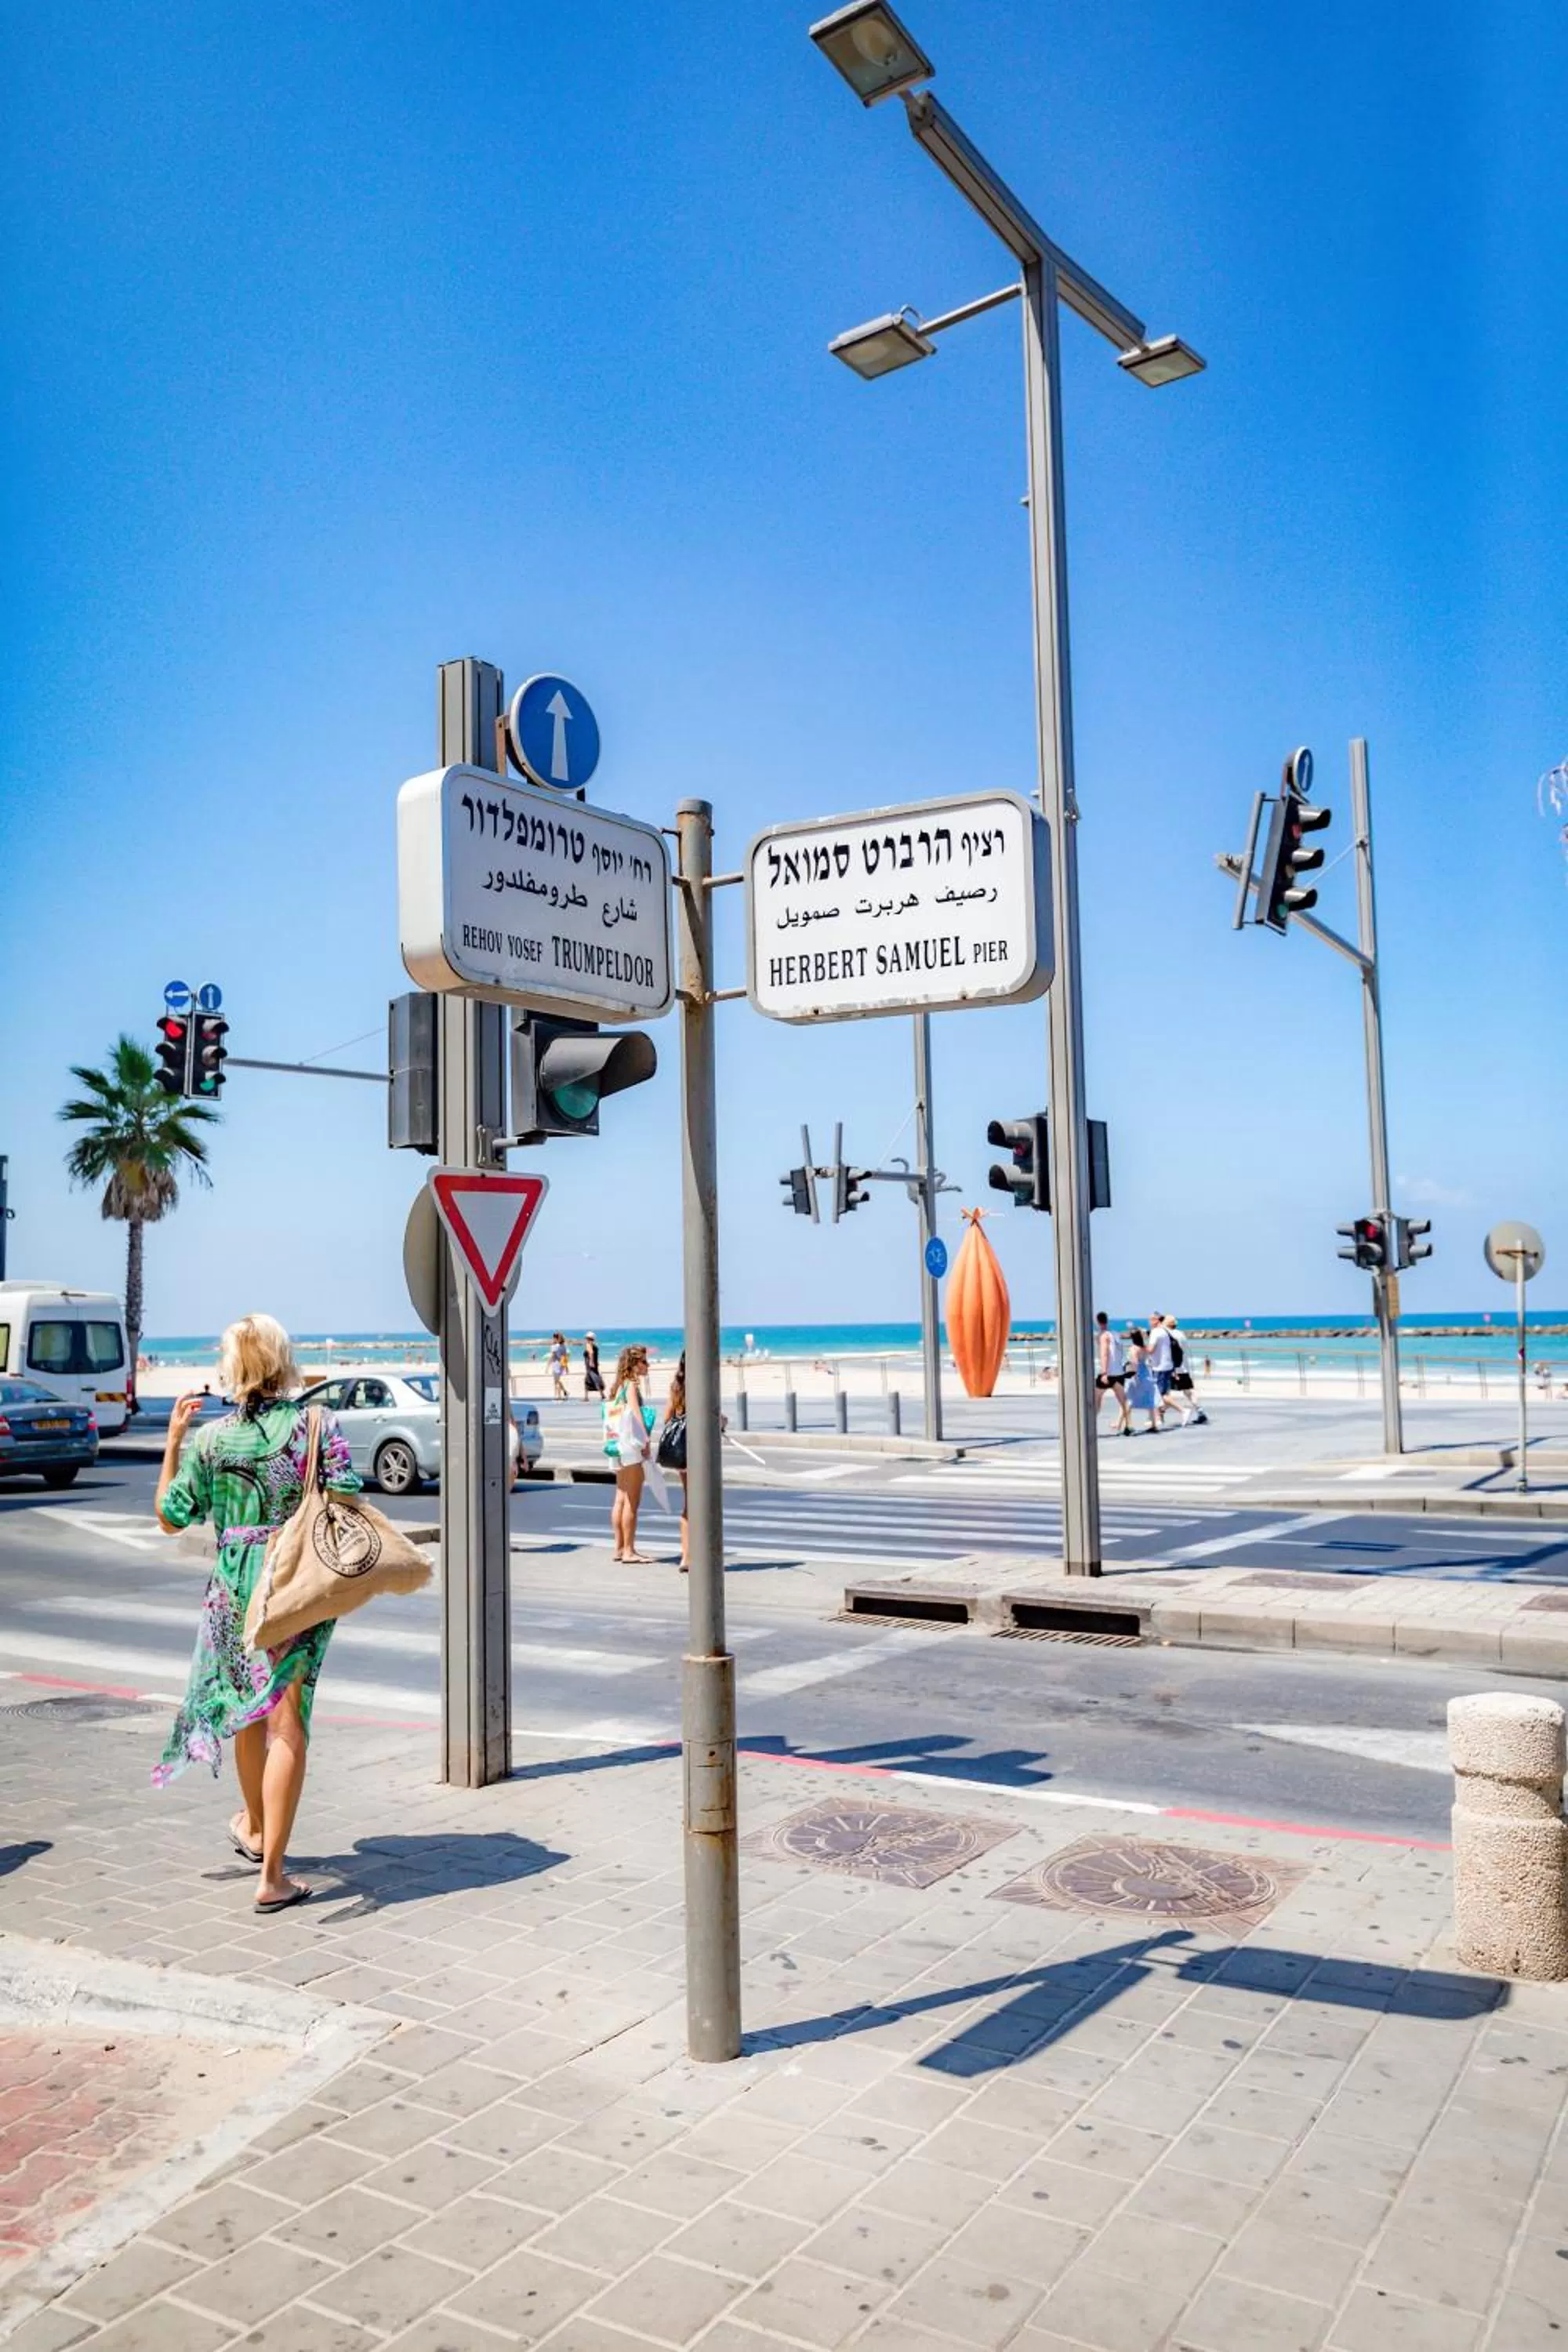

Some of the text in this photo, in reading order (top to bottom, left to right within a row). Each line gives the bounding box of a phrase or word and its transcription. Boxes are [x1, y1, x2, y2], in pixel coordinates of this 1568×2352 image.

[462, 793, 586, 865] טרומפלדור
[768, 827, 1005, 889] רציף הרברט סמואל
[592, 843, 624, 876] יוסף
[482, 869, 637, 927] شارع طرومفلدور
[777, 884, 998, 929] رصيف هربرت صمويل
[463, 924, 655, 988] REHOV YOSEF TRUMPELDOR
[769, 935, 1009, 987] HERBERT SAMUEL PIER
